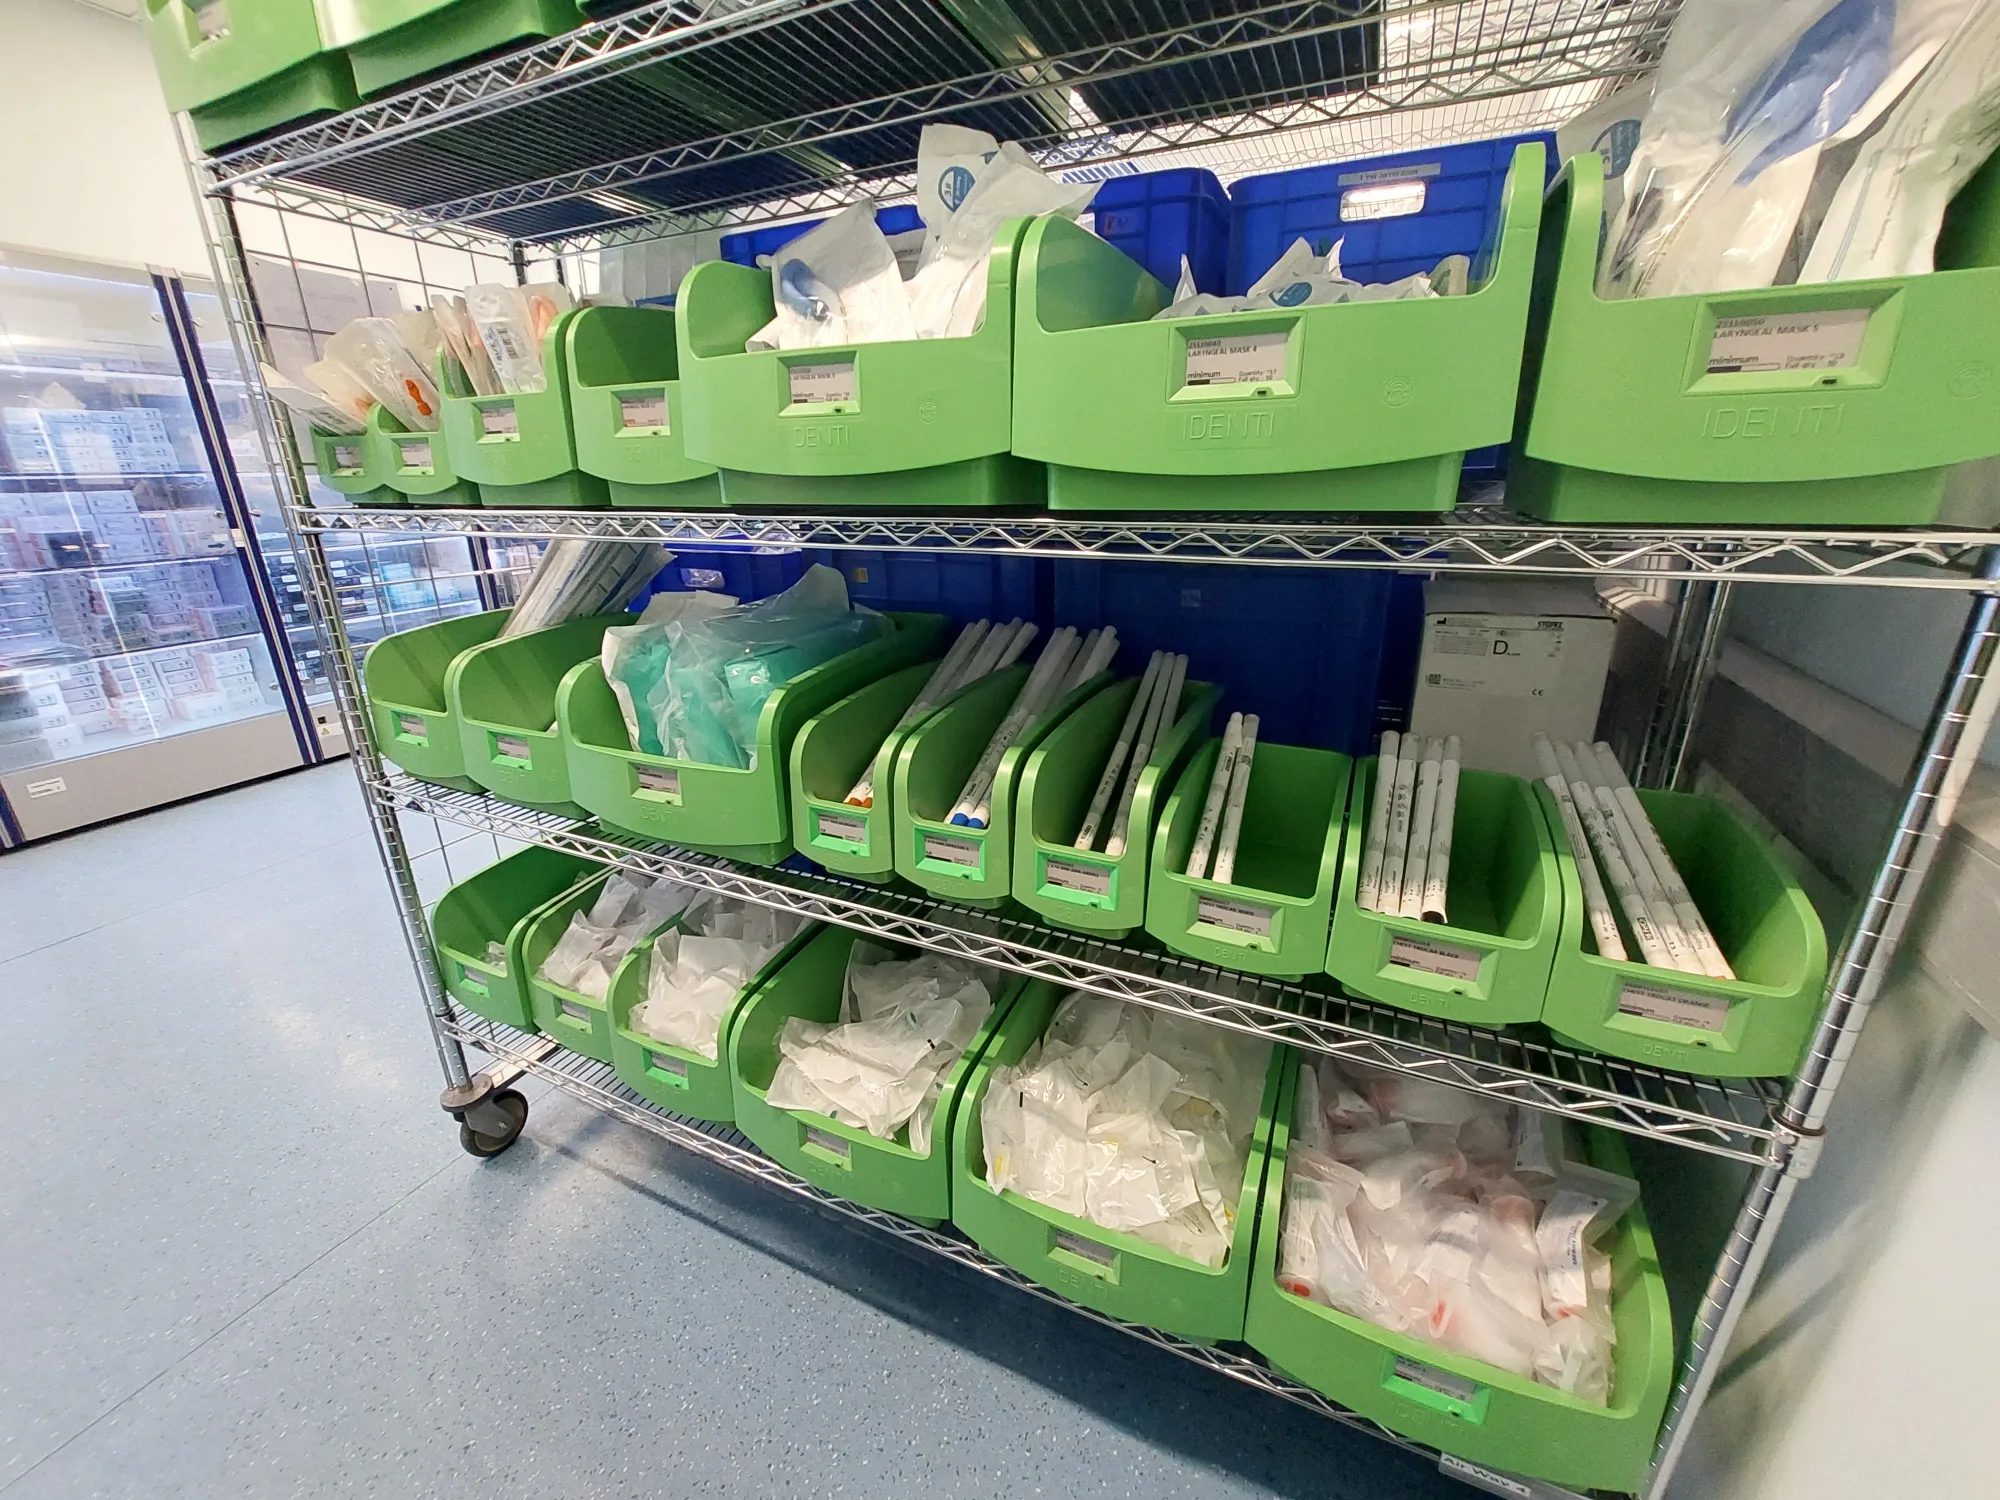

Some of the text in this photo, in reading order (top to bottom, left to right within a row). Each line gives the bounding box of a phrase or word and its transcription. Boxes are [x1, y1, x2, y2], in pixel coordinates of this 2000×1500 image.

[1713, 327, 1774, 339] LARYNGEAL
[1777, 325, 1810, 336] MASK
[1188, 348, 1227, 358] LARYNGEAL
[1230, 346, 1251, 355] MASK
[1708, 355, 1759, 365] minimum
[1188, 370, 1221, 379] minimum
[1182, 412, 1275, 440] IDENTI
